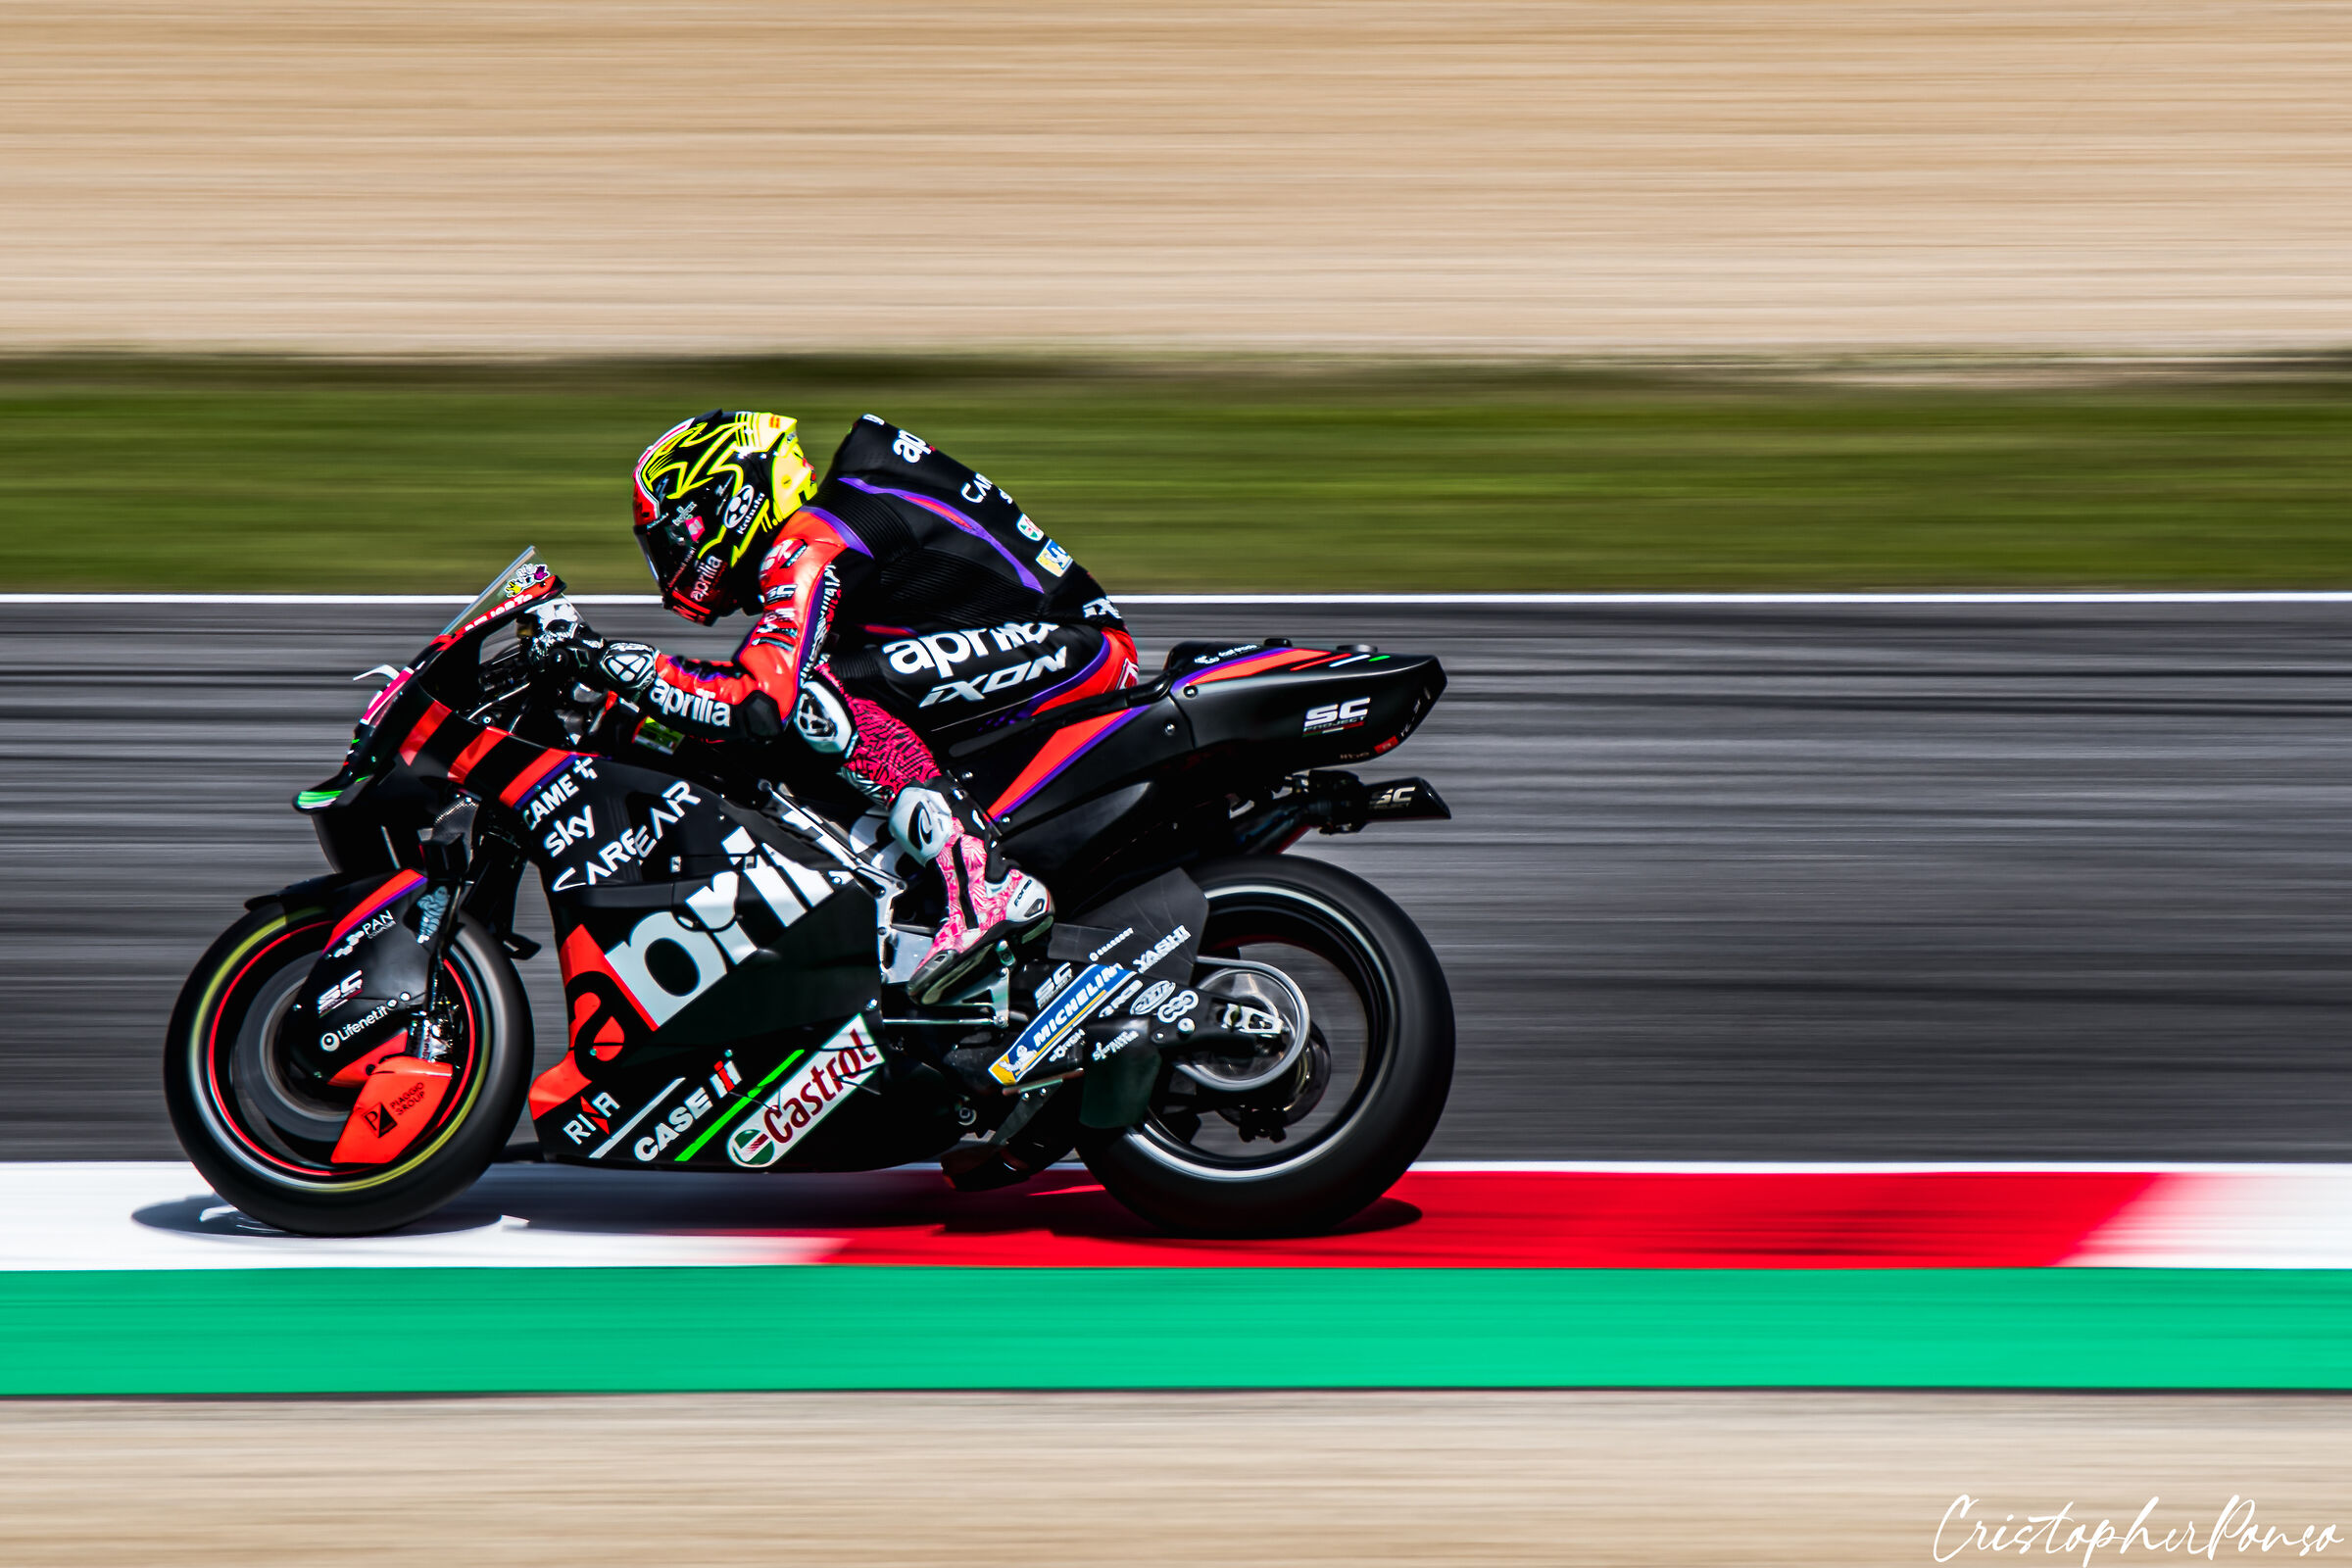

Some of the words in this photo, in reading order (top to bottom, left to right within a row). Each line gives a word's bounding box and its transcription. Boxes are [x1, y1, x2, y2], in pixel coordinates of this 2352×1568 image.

[690, 555, 723, 602] aprilia
[649, 676, 731, 727] aprilia
[1303, 697, 1371, 728] SC
[522, 773, 580, 831] CAME
[543, 805, 596, 858] sky
[363, 909, 394, 935] PAN
[1132, 924, 1192, 974] YASHI
[1032, 962, 1124, 1048] MICHELIN
[389, 1081, 424, 1109] PIAGGIO
[395, 1091, 425, 1116] GROUP
[763, 1027, 878, 1146] Castrol
[634, 1087, 713, 1162] CASE
